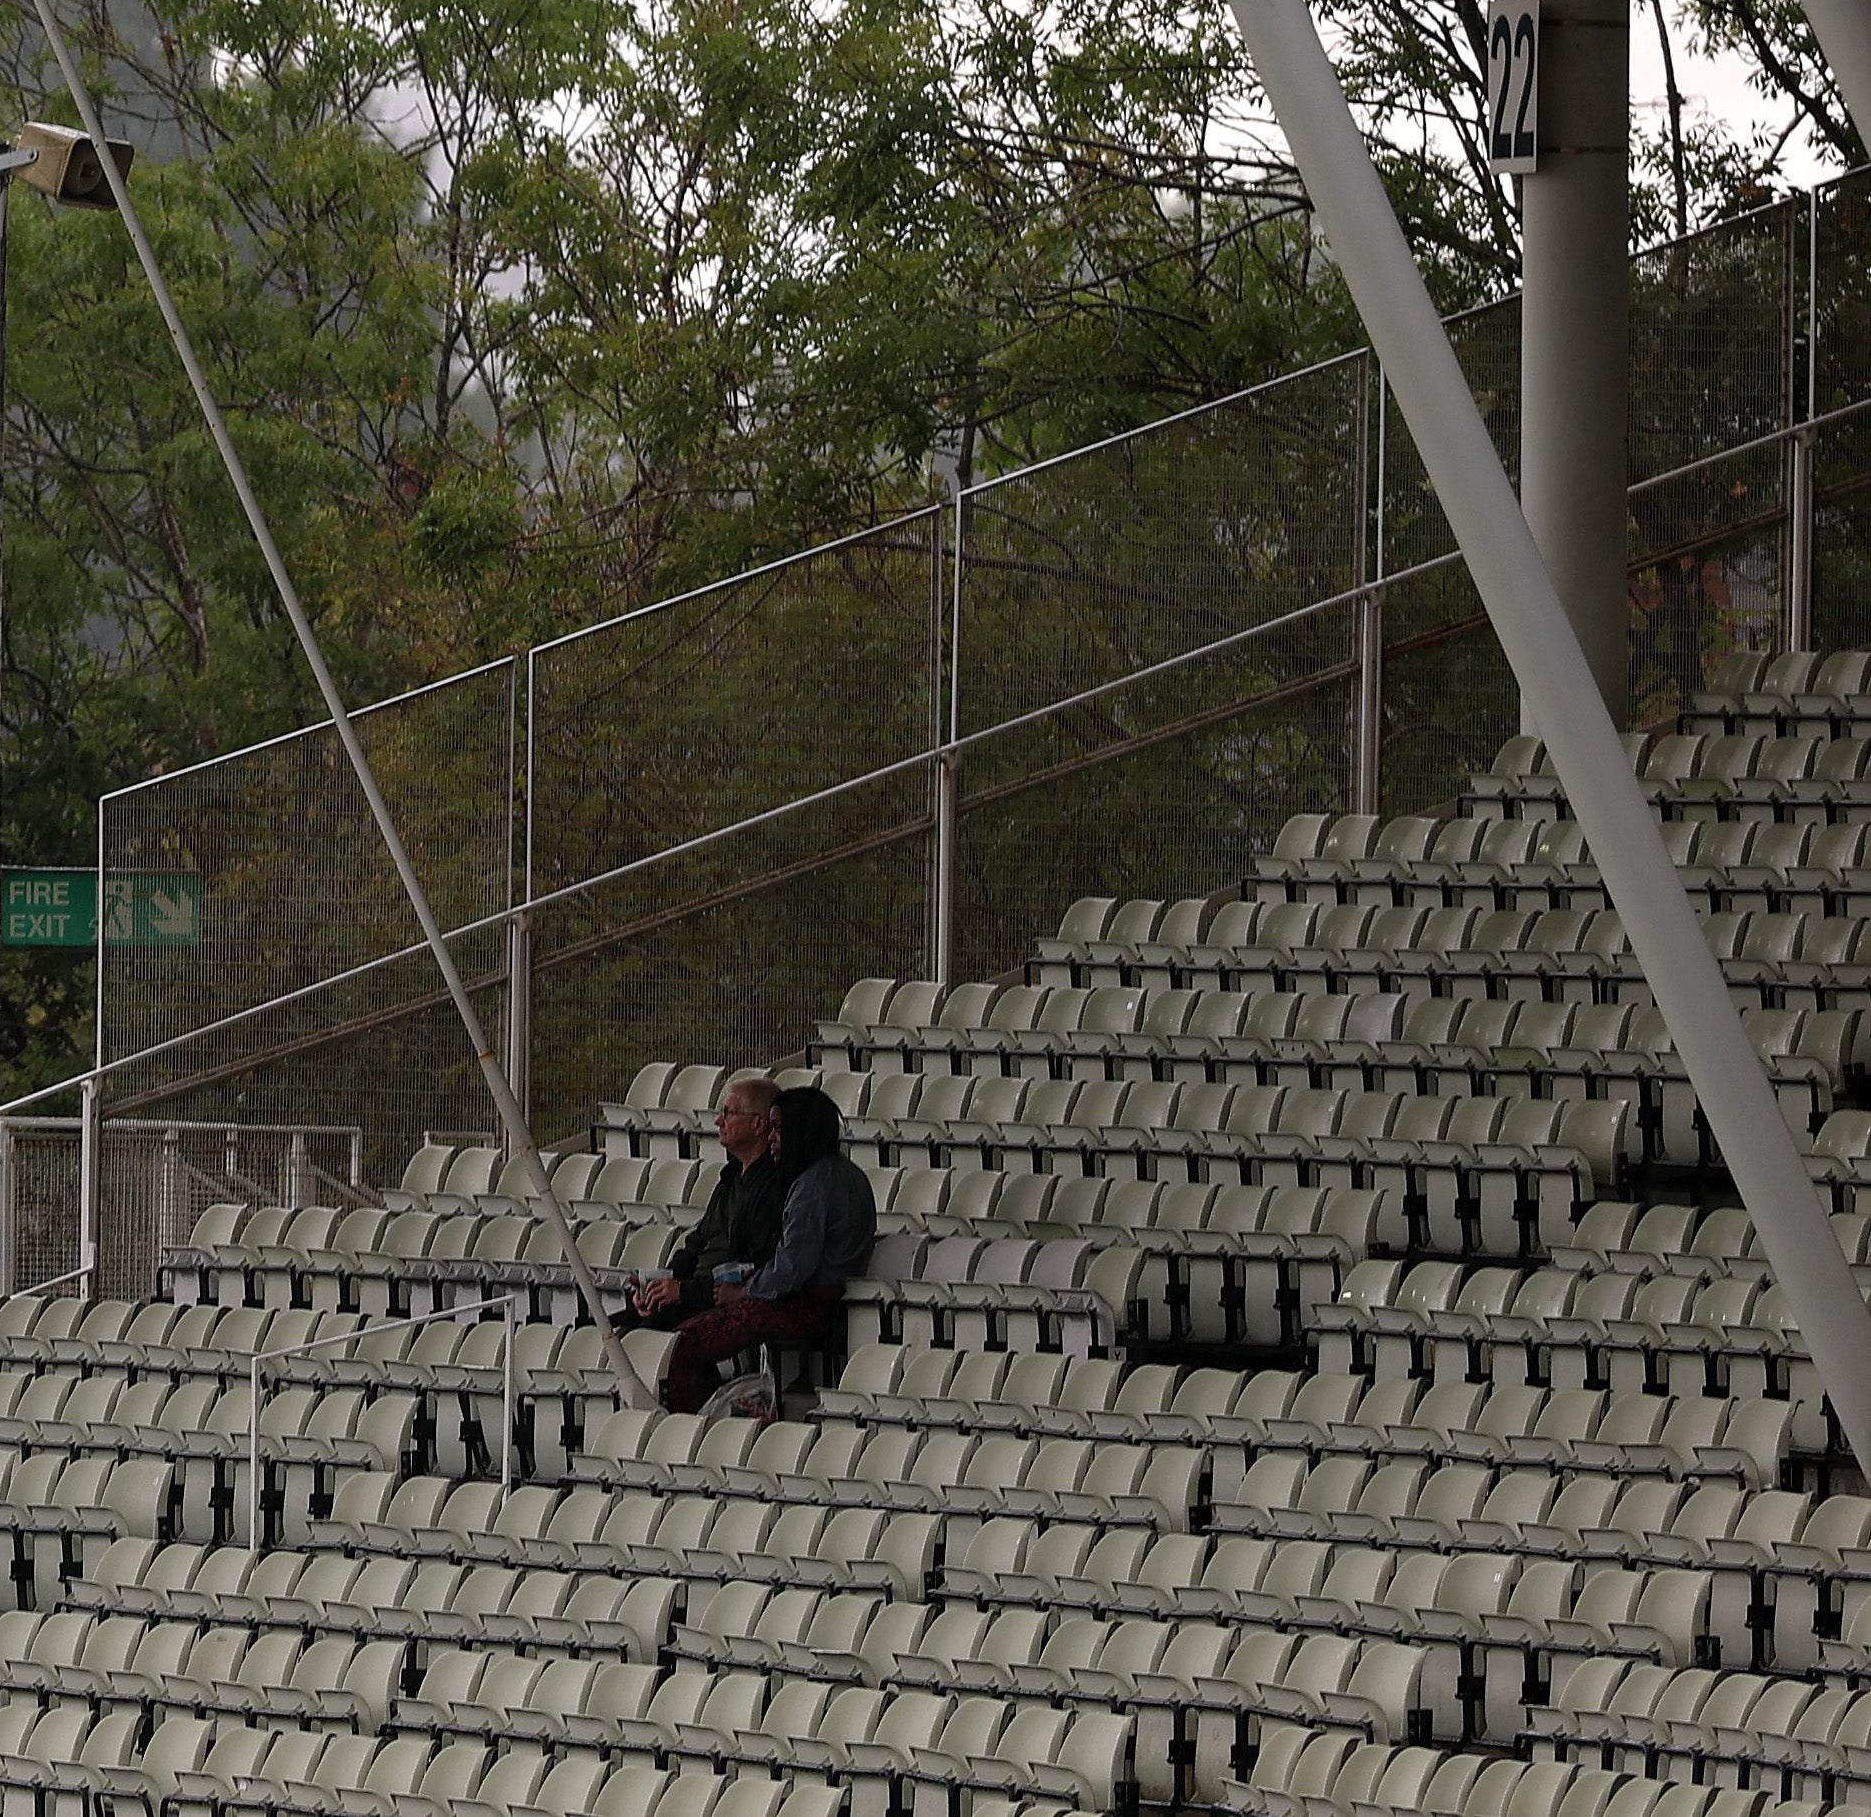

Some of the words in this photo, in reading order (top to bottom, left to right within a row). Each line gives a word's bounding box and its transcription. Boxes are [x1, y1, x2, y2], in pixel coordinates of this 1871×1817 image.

[1490, 12, 1535, 160] 22
[9, 880, 70, 906] FIRE
[9, 913, 70, 938] EXIT
